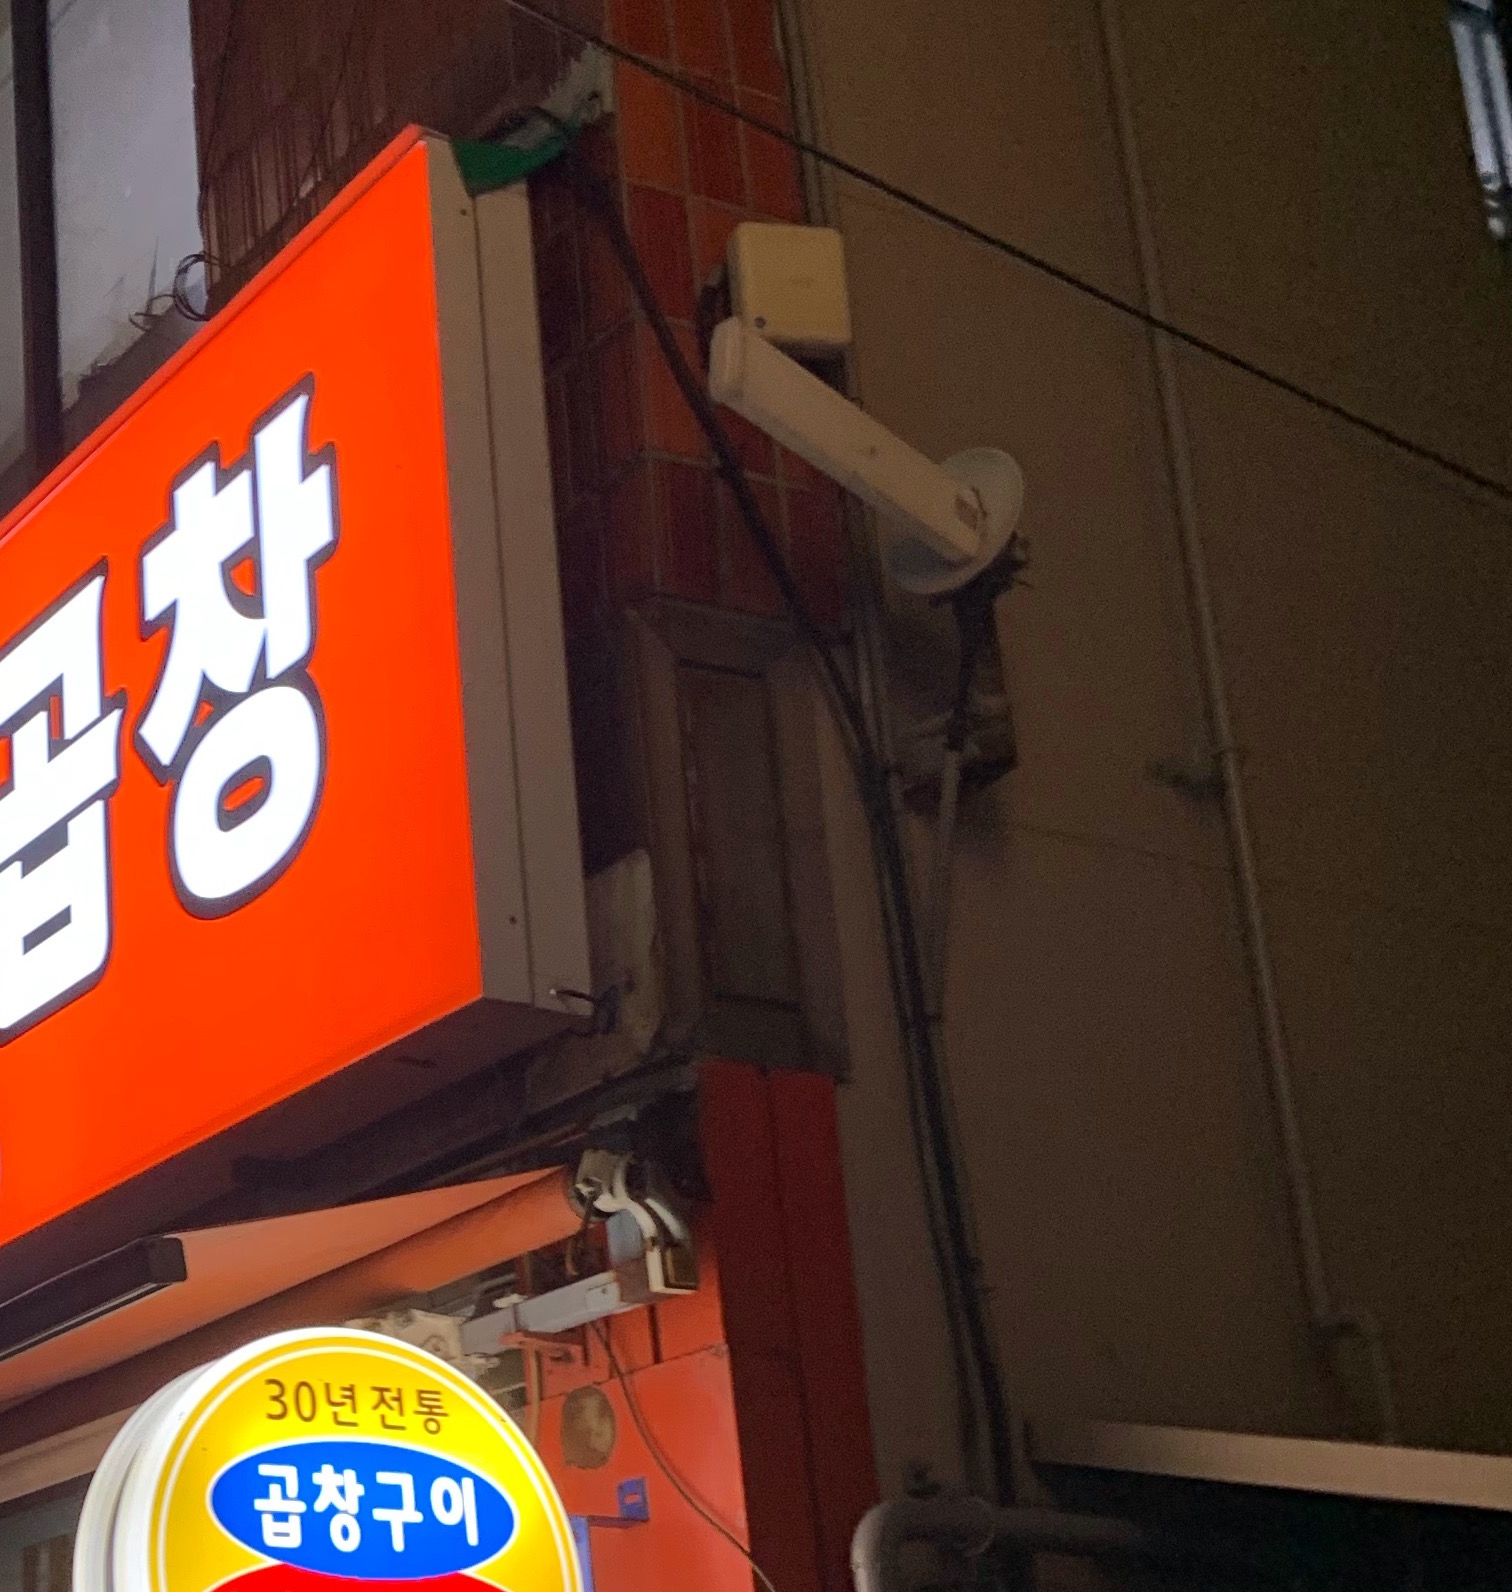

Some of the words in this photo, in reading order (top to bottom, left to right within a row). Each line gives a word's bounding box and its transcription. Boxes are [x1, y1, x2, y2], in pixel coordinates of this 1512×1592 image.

[264, 1377, 360, 1429] 30년
[369, 1384, 451, 1436] 전통
[252, 1461, 480, 1554] 곱창구이
